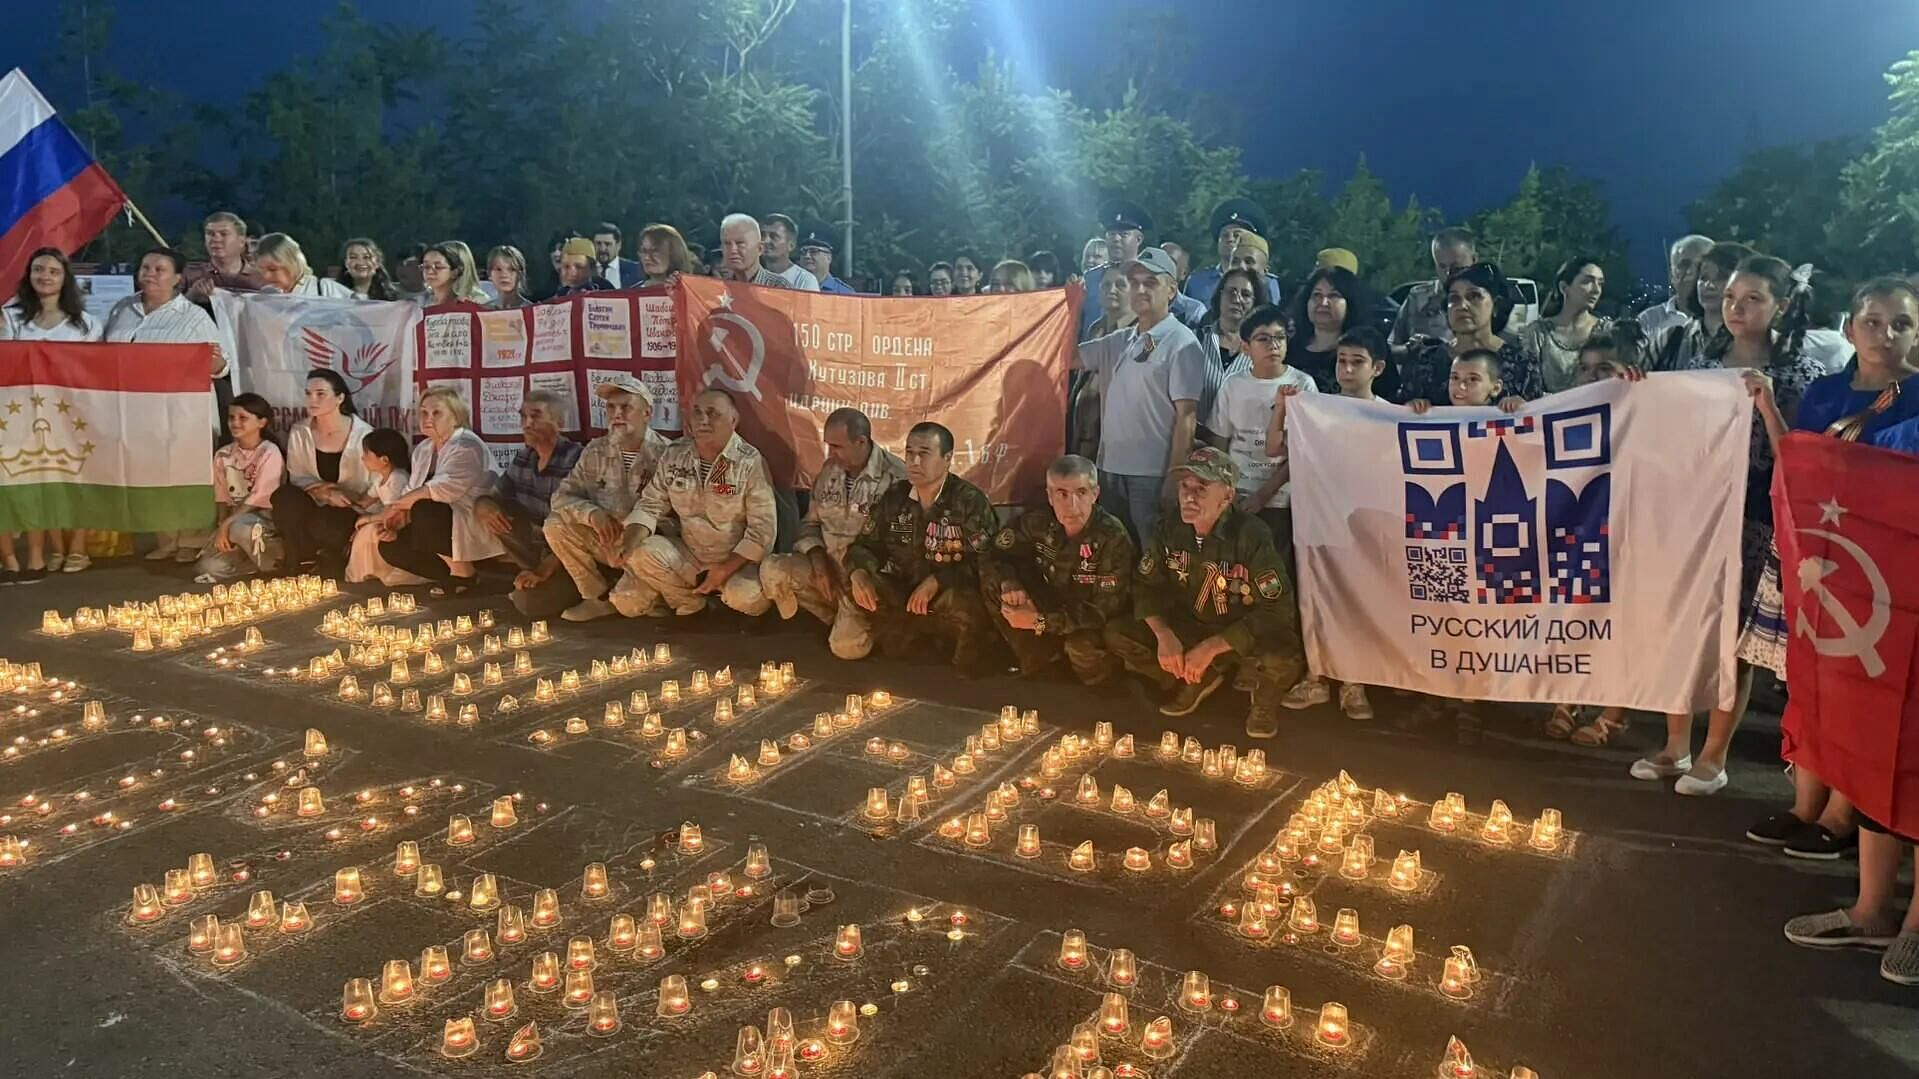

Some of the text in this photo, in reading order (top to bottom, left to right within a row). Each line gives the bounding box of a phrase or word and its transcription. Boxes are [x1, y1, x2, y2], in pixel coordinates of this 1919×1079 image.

[793, 323, 820, 349] 150
[1411, 614, 1612, 645] РУССКИЙ ДОМ
[1431, 649, 1592, 676] В ДУШАНБЕ
